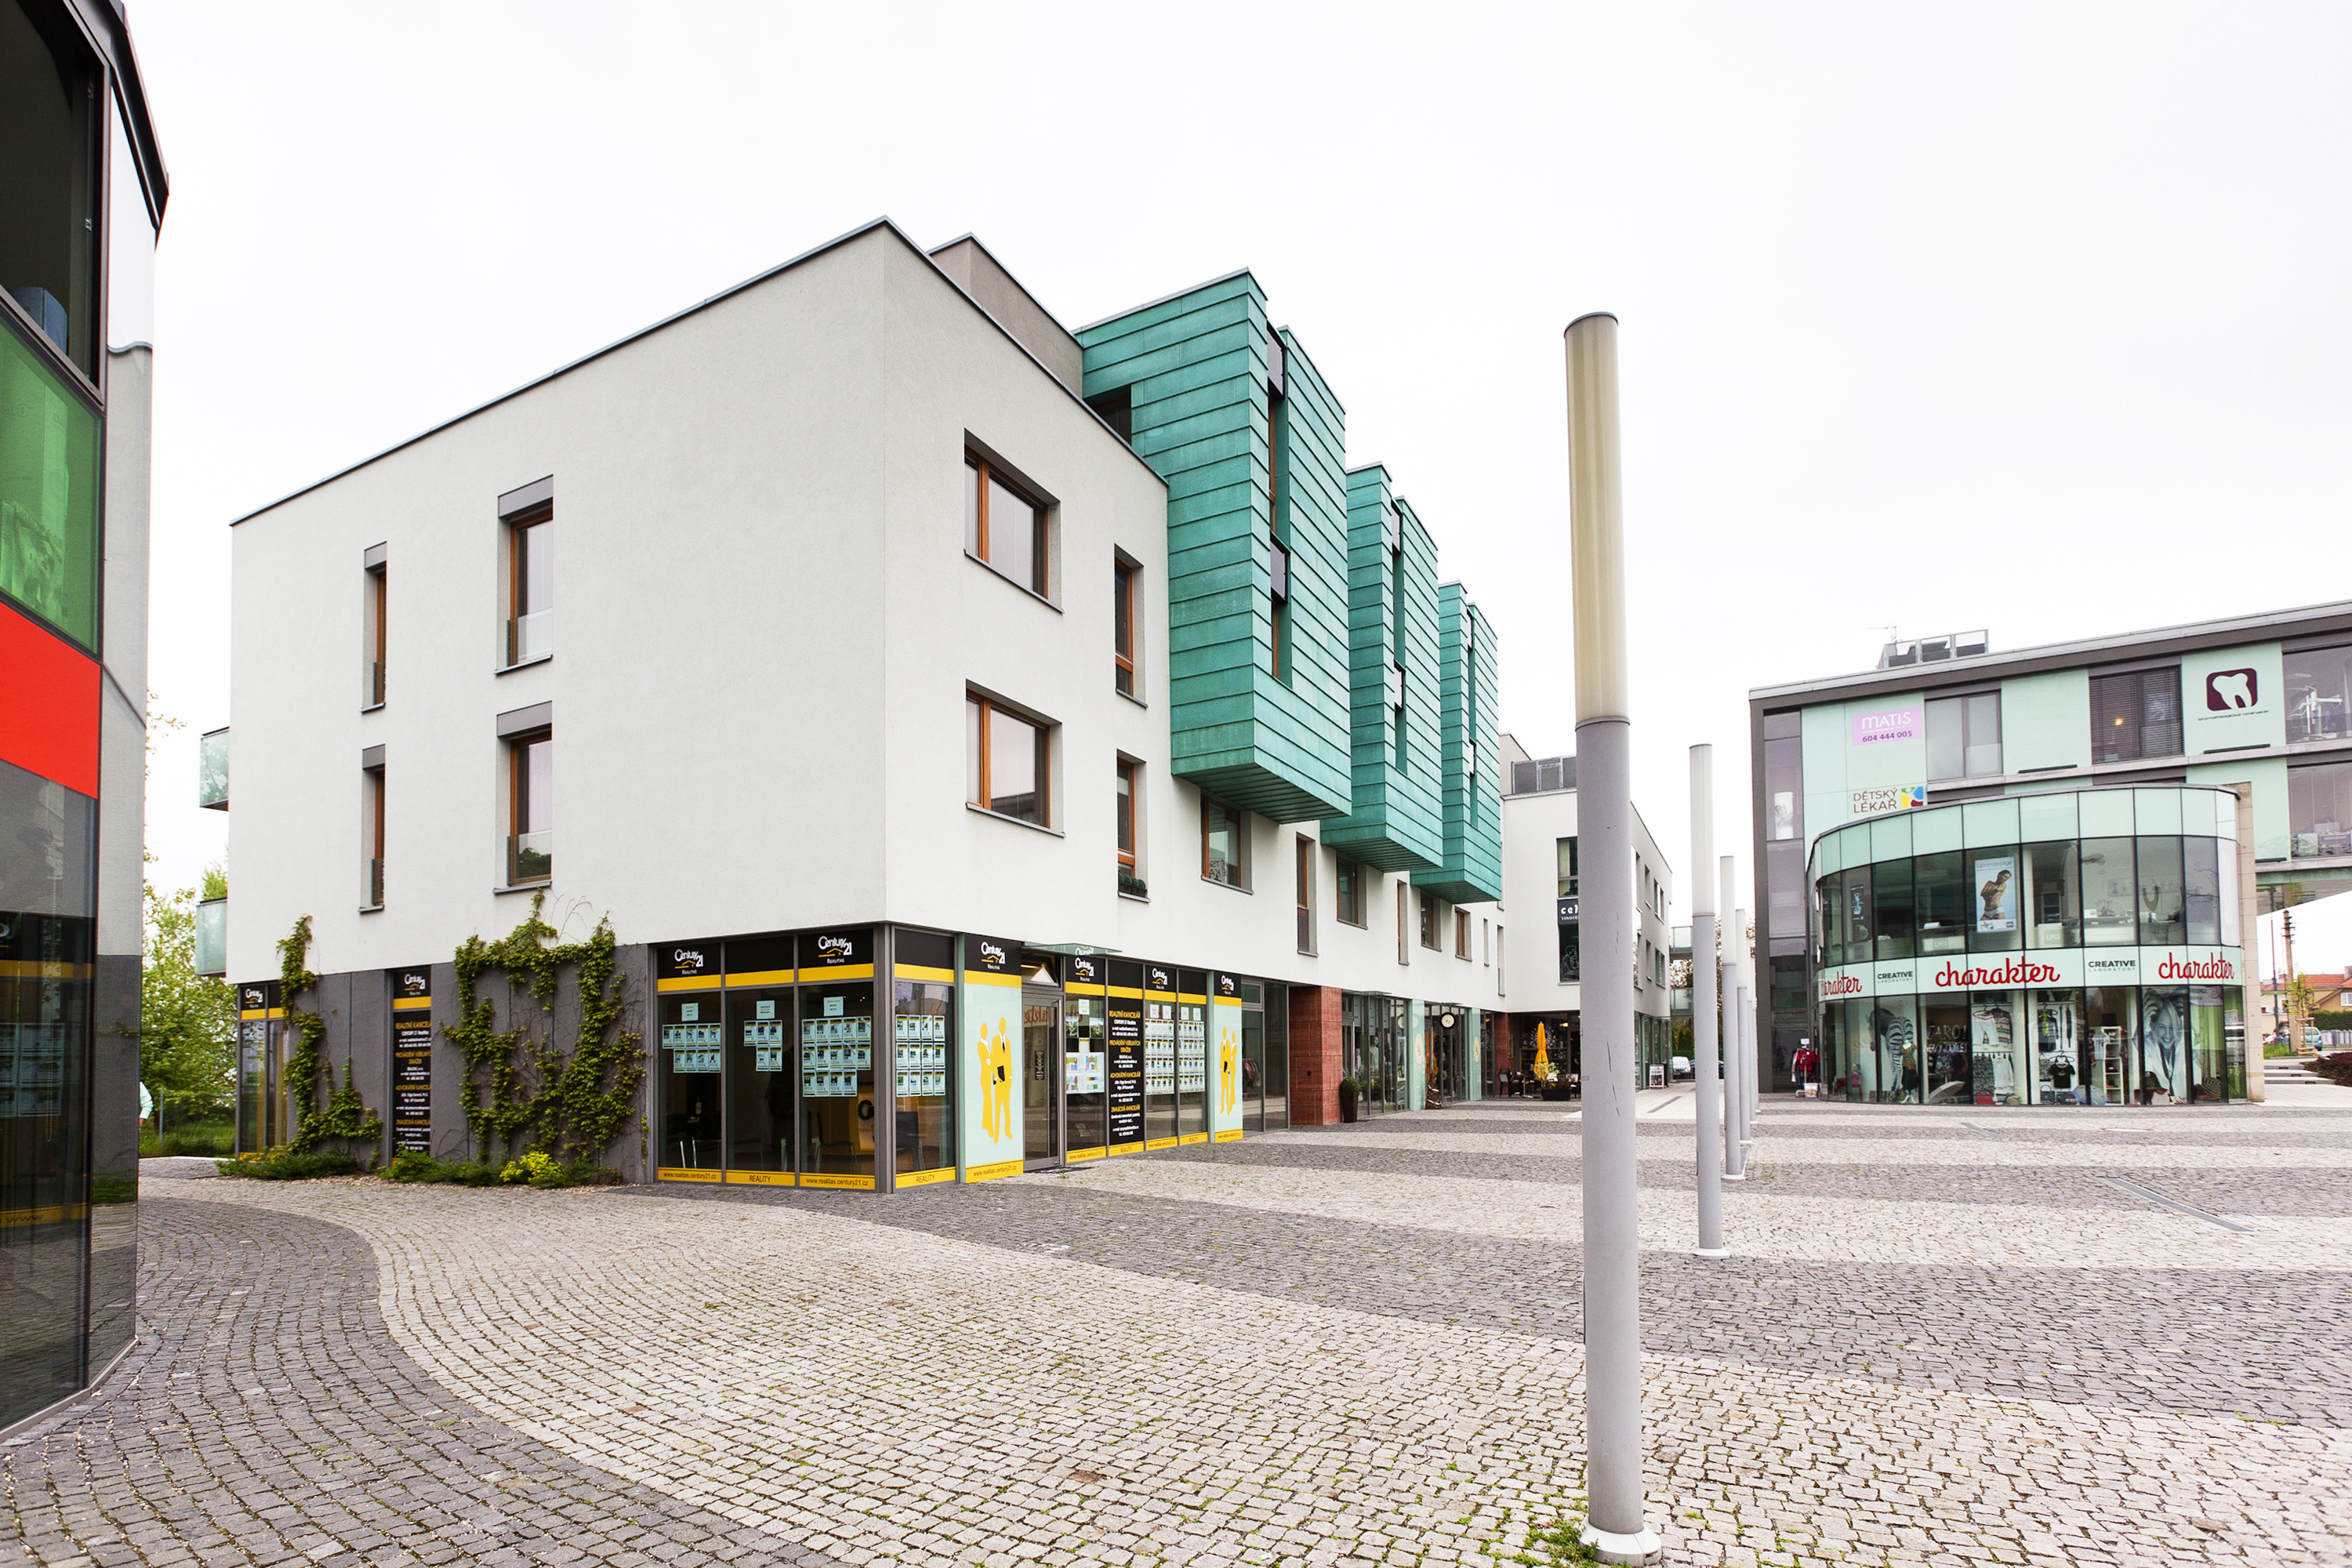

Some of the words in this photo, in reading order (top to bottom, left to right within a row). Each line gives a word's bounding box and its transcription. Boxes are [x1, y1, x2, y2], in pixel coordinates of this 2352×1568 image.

[1896, 730, 1912, 739] 005
[1853, 786, 1898, 801] DĚTSKÝ
[1853, 798, 1897, 813] LÉKAŘ
[818, 935, 847, 950] Century
[843, 942, 852, 956] 21
[674, 949, 699, 962] Century
[695, 954, 704, 967] 21
[2089, 960, 2136, 968] CREATIVE
[1935, 955, 2061, 987] charakter
[2158, 951, 2235, 980] charakter
[1876, 971, 1913, 980] CREATIVE
[663, 1171, 717, 1180] www.realitas.century21.cz
[973, 1165, 1017, 1177] www.realitas.century21.cz
[806, 1178, 869, 1187] www.realitas.century21.cz
[916, 1174, 935, 1183] REALITY
